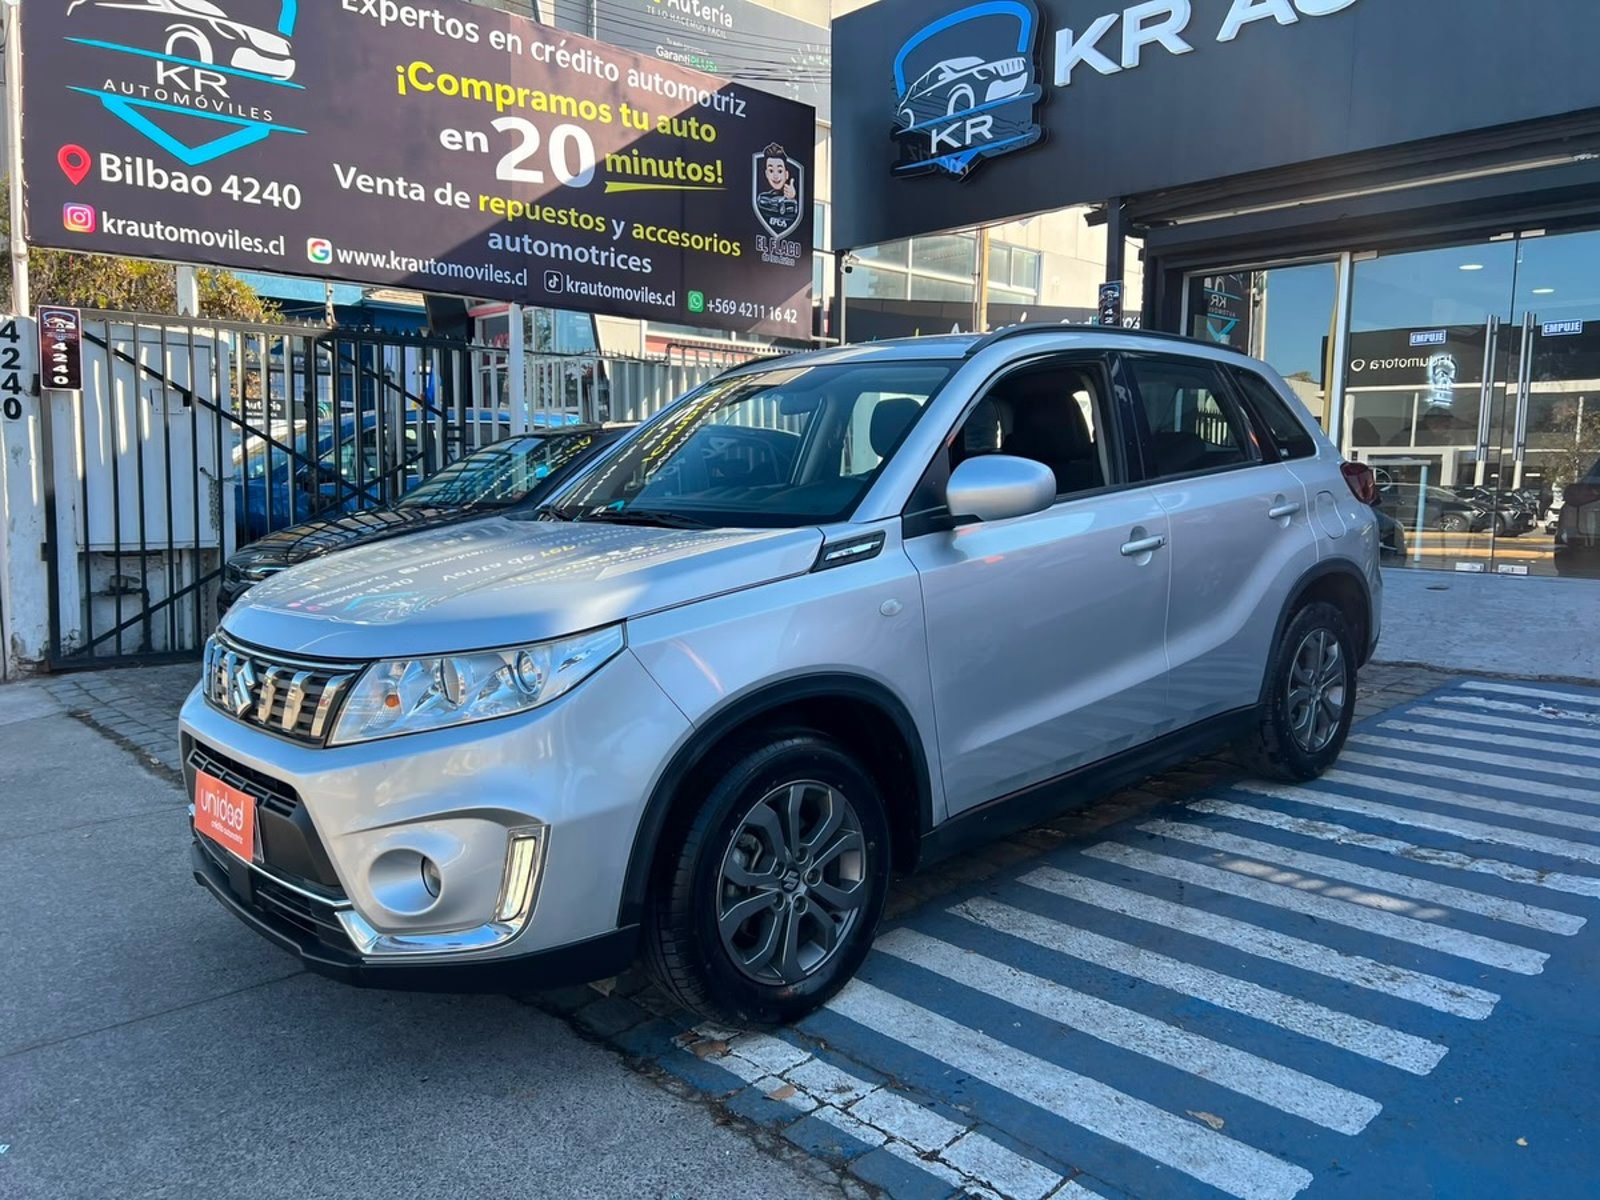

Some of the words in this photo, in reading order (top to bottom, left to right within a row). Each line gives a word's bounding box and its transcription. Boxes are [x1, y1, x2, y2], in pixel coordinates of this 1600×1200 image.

[342, 0, 479, 44] Expertos
[489, 28, 523, 54] en
[531, 39, 620, 82] crédito
[627, 67, 747, 118] automotriz
[1054, 0, 1194, 87] KR
[103, 78, 274, 122] AUTOMÓVILES
[156, 62, 231, 98] KR
[396, 60, 614, 123] ¡Compramos
[619, 104, 650, 132] tu
[657, 114, 718, 144] auto
[440, 127, 488, 153] en
[489, 116, 596, 189] 20
[604, 150, 724, 185] minutos!
[931, 115, 994, 154] KR
[100, 153, 213, 197] Bilbao
[221, 173, 302, 211] 4240
[333, 163, 426, 203] Venta
[434, 182, 471, 211] de
[479, 192, 605, 233] repuestos
[611, 219, 625, 240] y
[632, 221, 742, 258] accesorios
[102, 211, 286, 257] krautomoviles.cl
[488, 231, 652, 273] automotrices
[337, 247, 528, 288] www.krautomoviles.cl
[566, 274, 676, 308] krautomoviles.cl
[707, 298, 736, 315] +569
[738, 301, 765, 319] 4211
[769, 306, 782, 322] 16
[783, 308, 798, 324] 42
[1411, 332, 1444, 344] EMPUJE
[1544, 321, 1580, 333] EMPUJE
[0, 320, 22, 420] 4240
[51, 342, 69, 385] 4240
[200, 788, 244, 831] unidad
